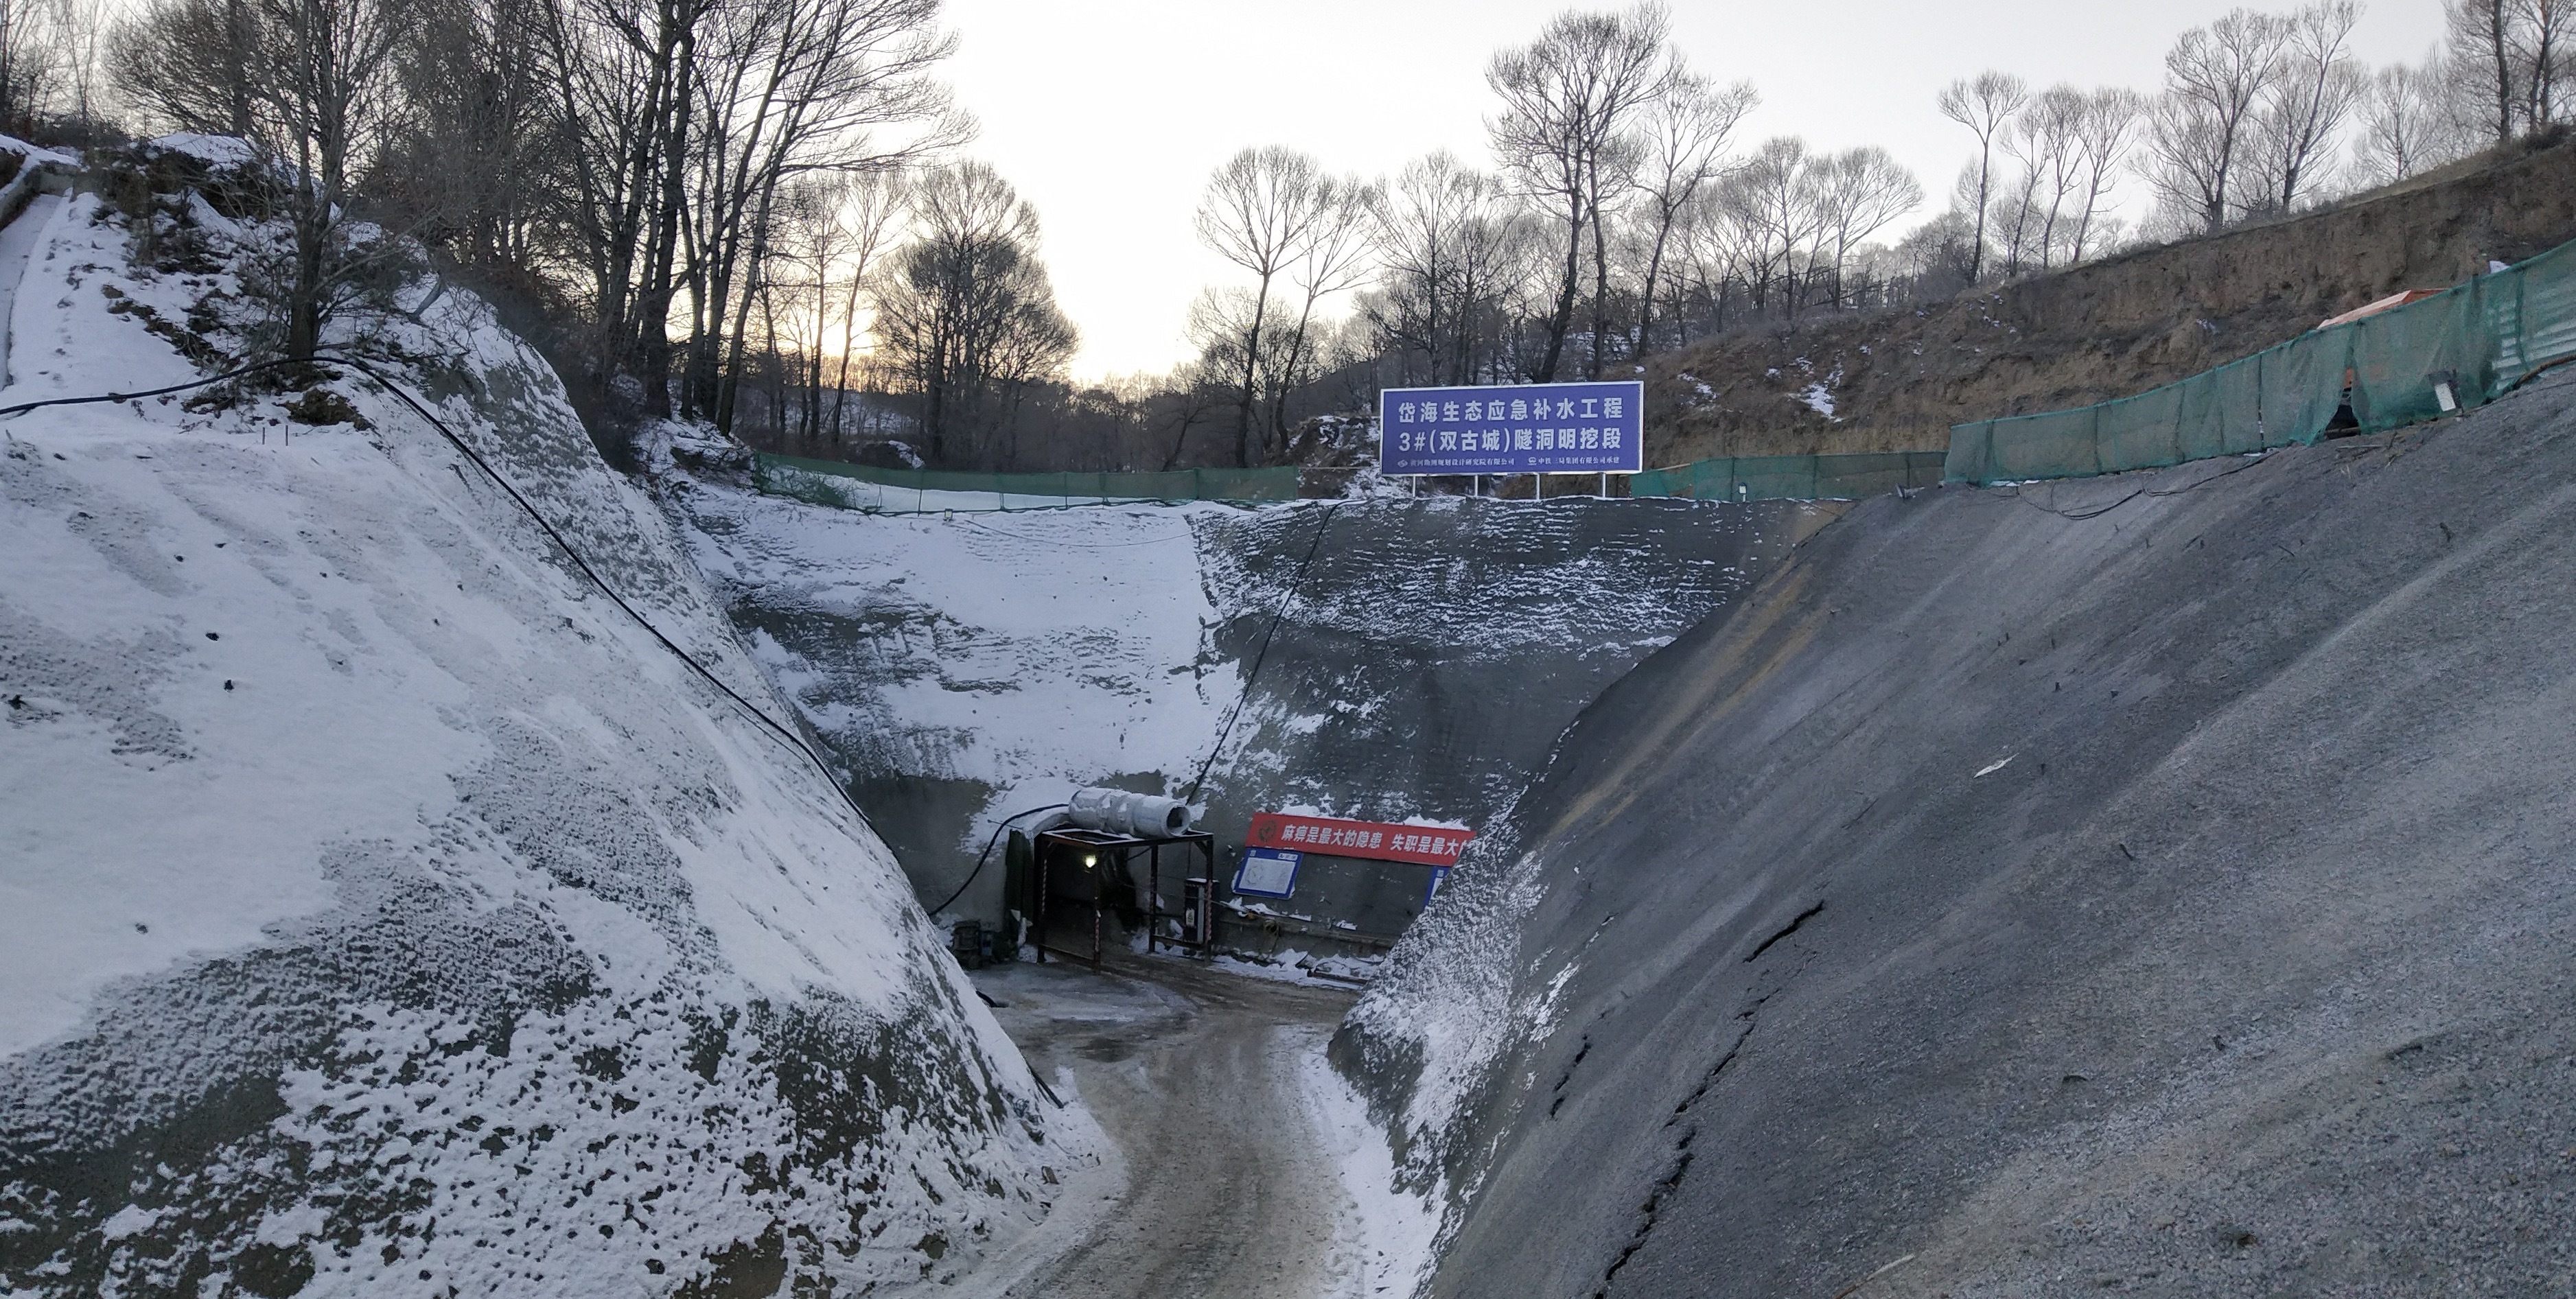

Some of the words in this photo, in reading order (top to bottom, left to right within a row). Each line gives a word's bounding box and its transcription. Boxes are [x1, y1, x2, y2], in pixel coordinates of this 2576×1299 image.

[1398, 397, 1623, 423] 岱海生态应急补水工程
[1281, 823, 1382, 849] 麻痹是最大的隐患
